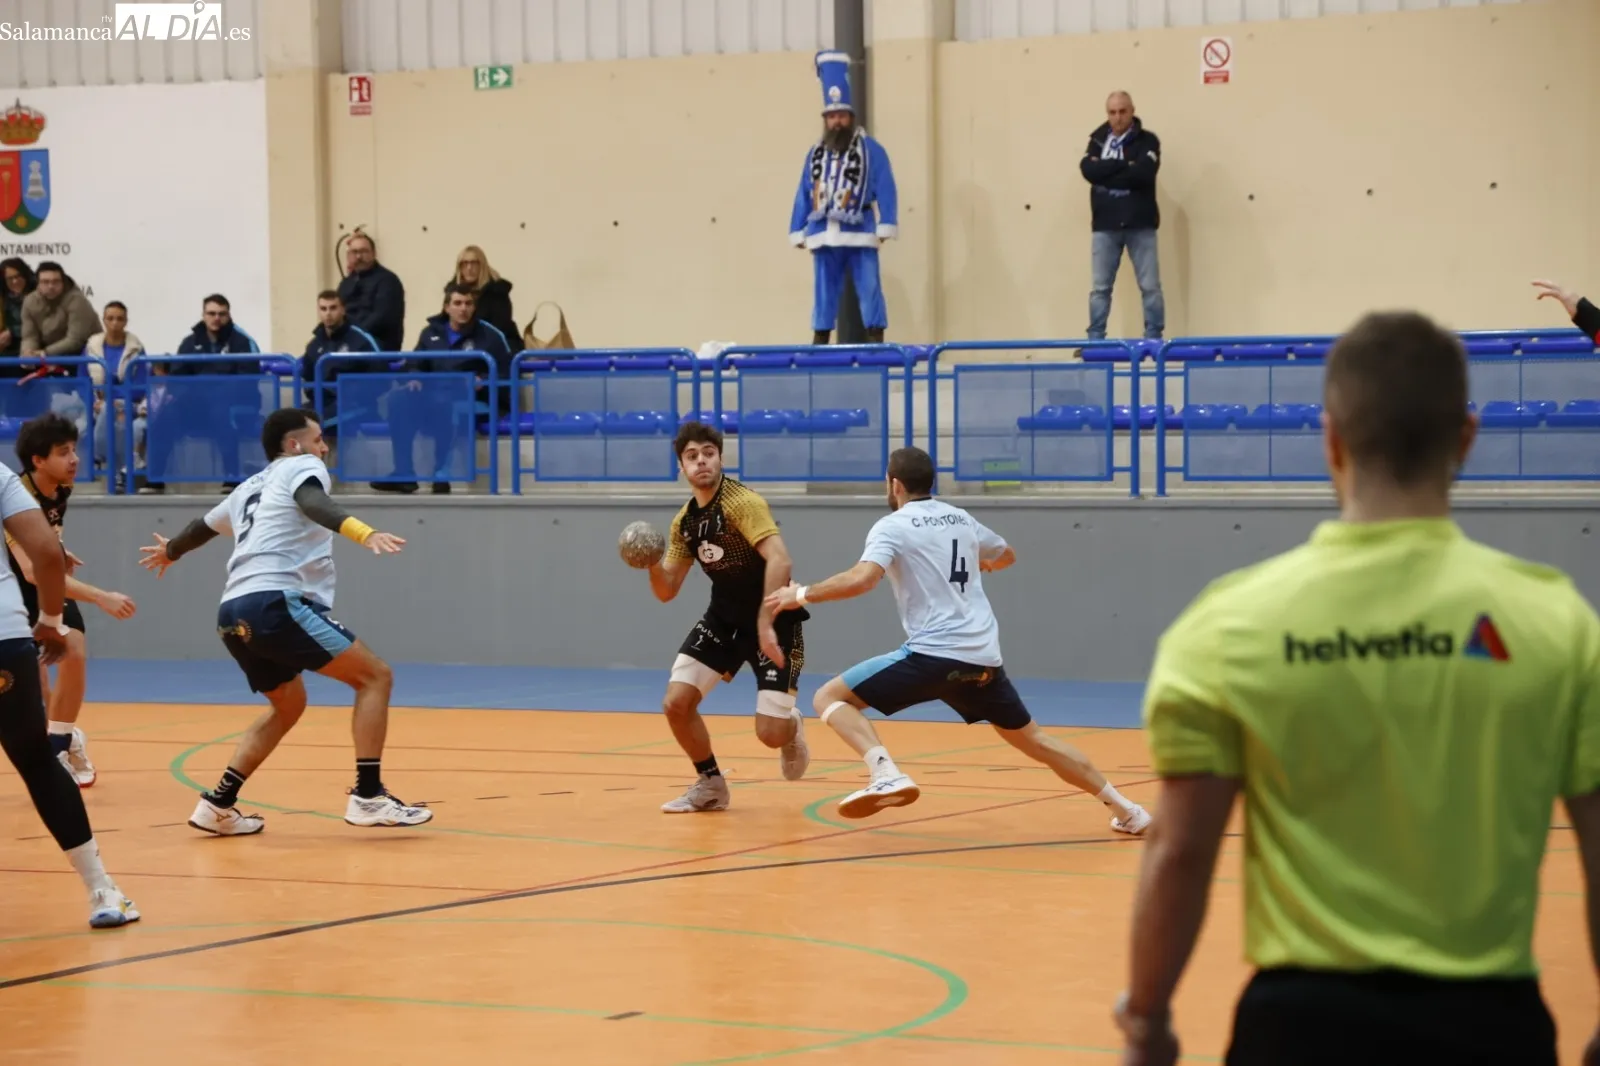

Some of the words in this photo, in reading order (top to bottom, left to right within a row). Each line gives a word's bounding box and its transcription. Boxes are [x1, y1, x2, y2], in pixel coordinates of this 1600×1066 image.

[0, 243, 71, 256] NTAMIENTO
[949, 538, 969, 593] 4
[1284, 622, 1454, 666] helvetia
